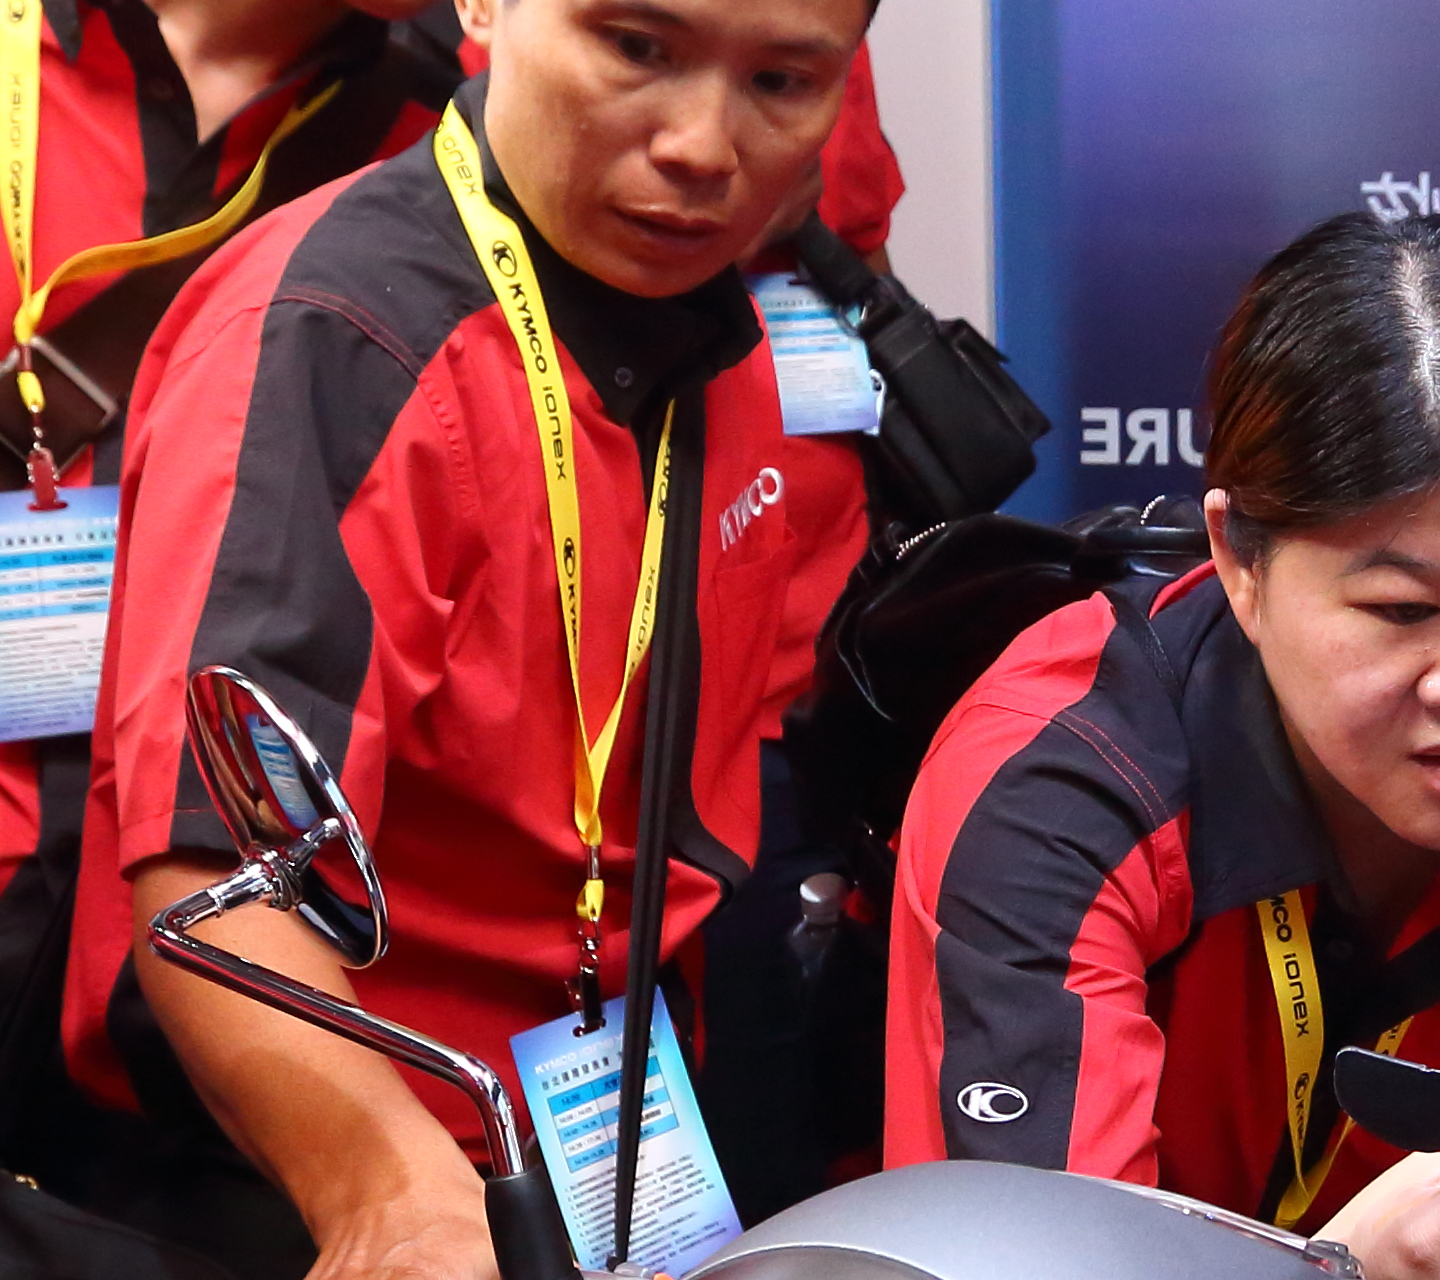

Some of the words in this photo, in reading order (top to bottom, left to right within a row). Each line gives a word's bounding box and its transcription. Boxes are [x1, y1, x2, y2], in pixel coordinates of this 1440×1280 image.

[509, 283, 547, 374] KYMCO
[542, 386, 566, 480] ionex
[719, 467, 784, 552] KYMCO
[1283, 952, 1309, 1037] ionex
